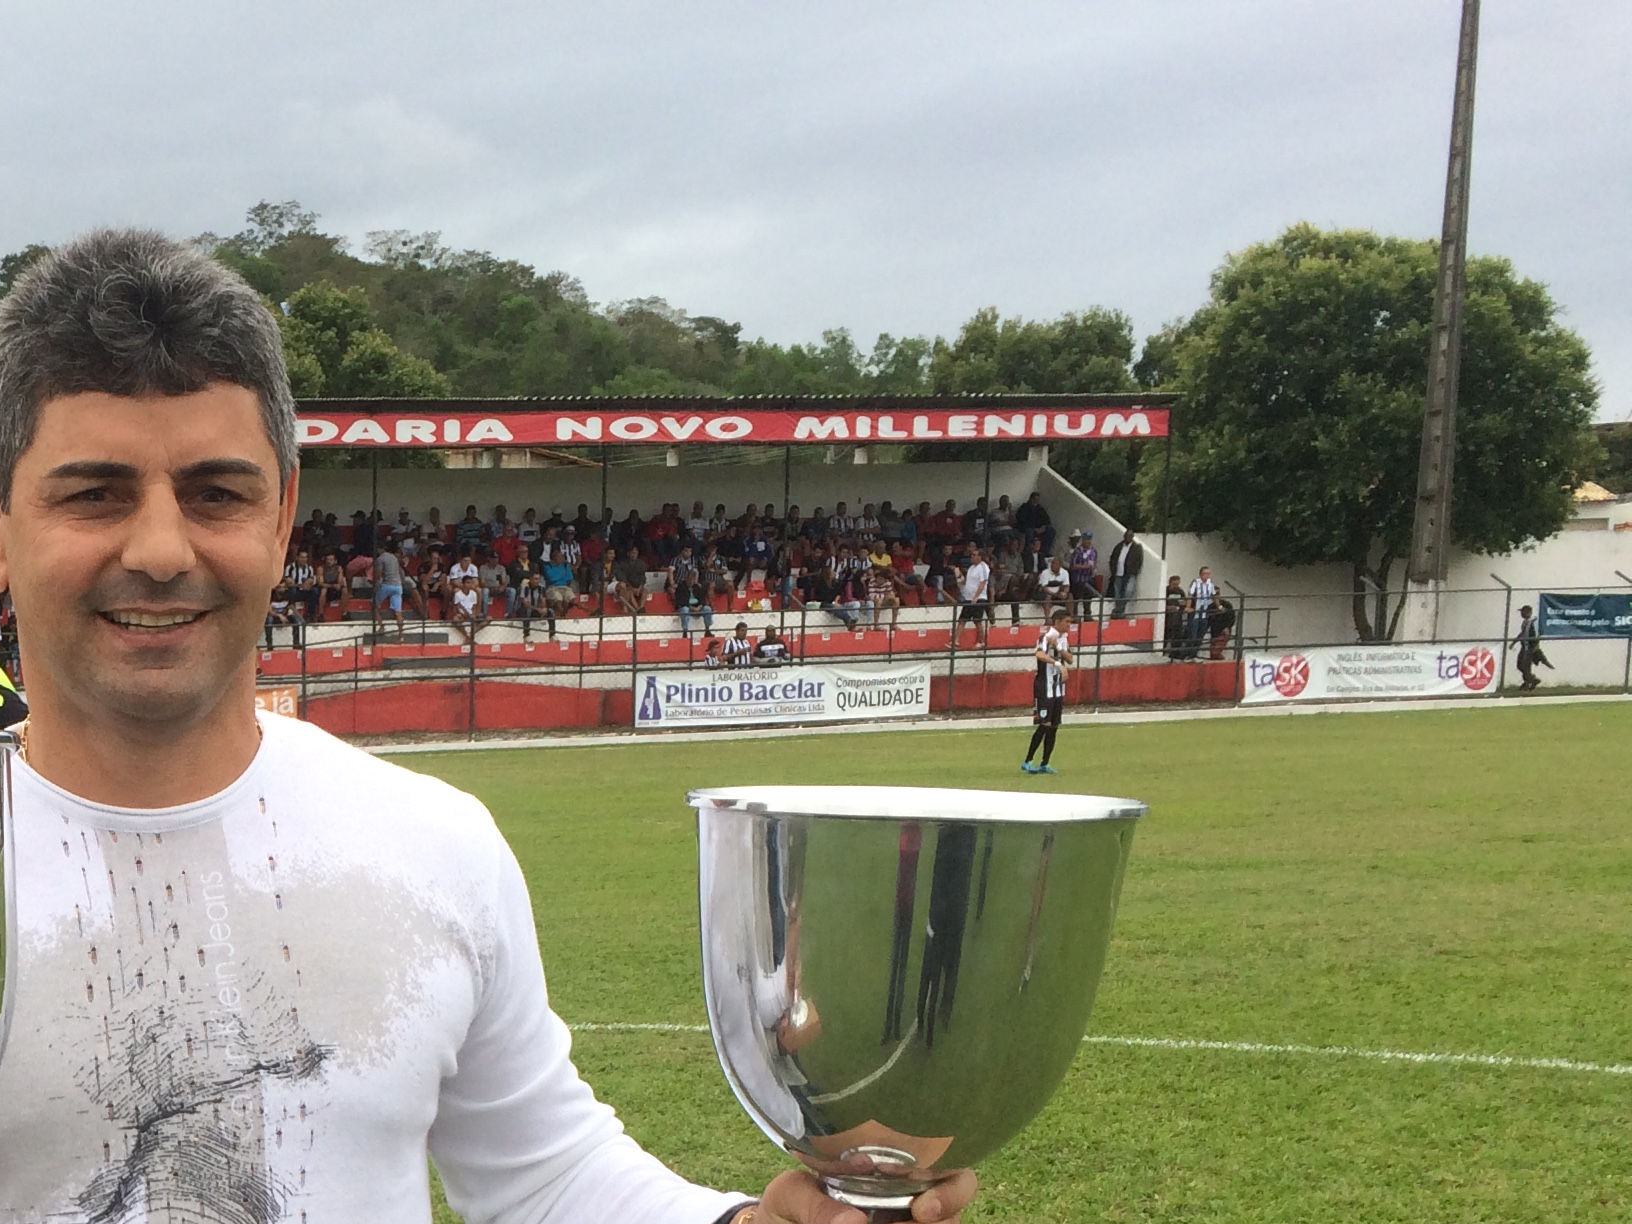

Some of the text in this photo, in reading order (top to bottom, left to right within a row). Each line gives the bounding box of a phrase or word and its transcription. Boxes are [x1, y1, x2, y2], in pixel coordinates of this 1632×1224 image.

[556, 416, 753, 441] NOVO
[793, 412, 1151, 439] MILLENIUM
[712, 671, 778, 682] LABORATÓRIO
[836, 676, 896, 688] Compromisso
[665, 678, 825, 703] Plinio Bacelar
[836, 688, 924, 711] QUALIDADE
[717, 706, 727, 716] de
[201, 871, 234, 957] Jeans
